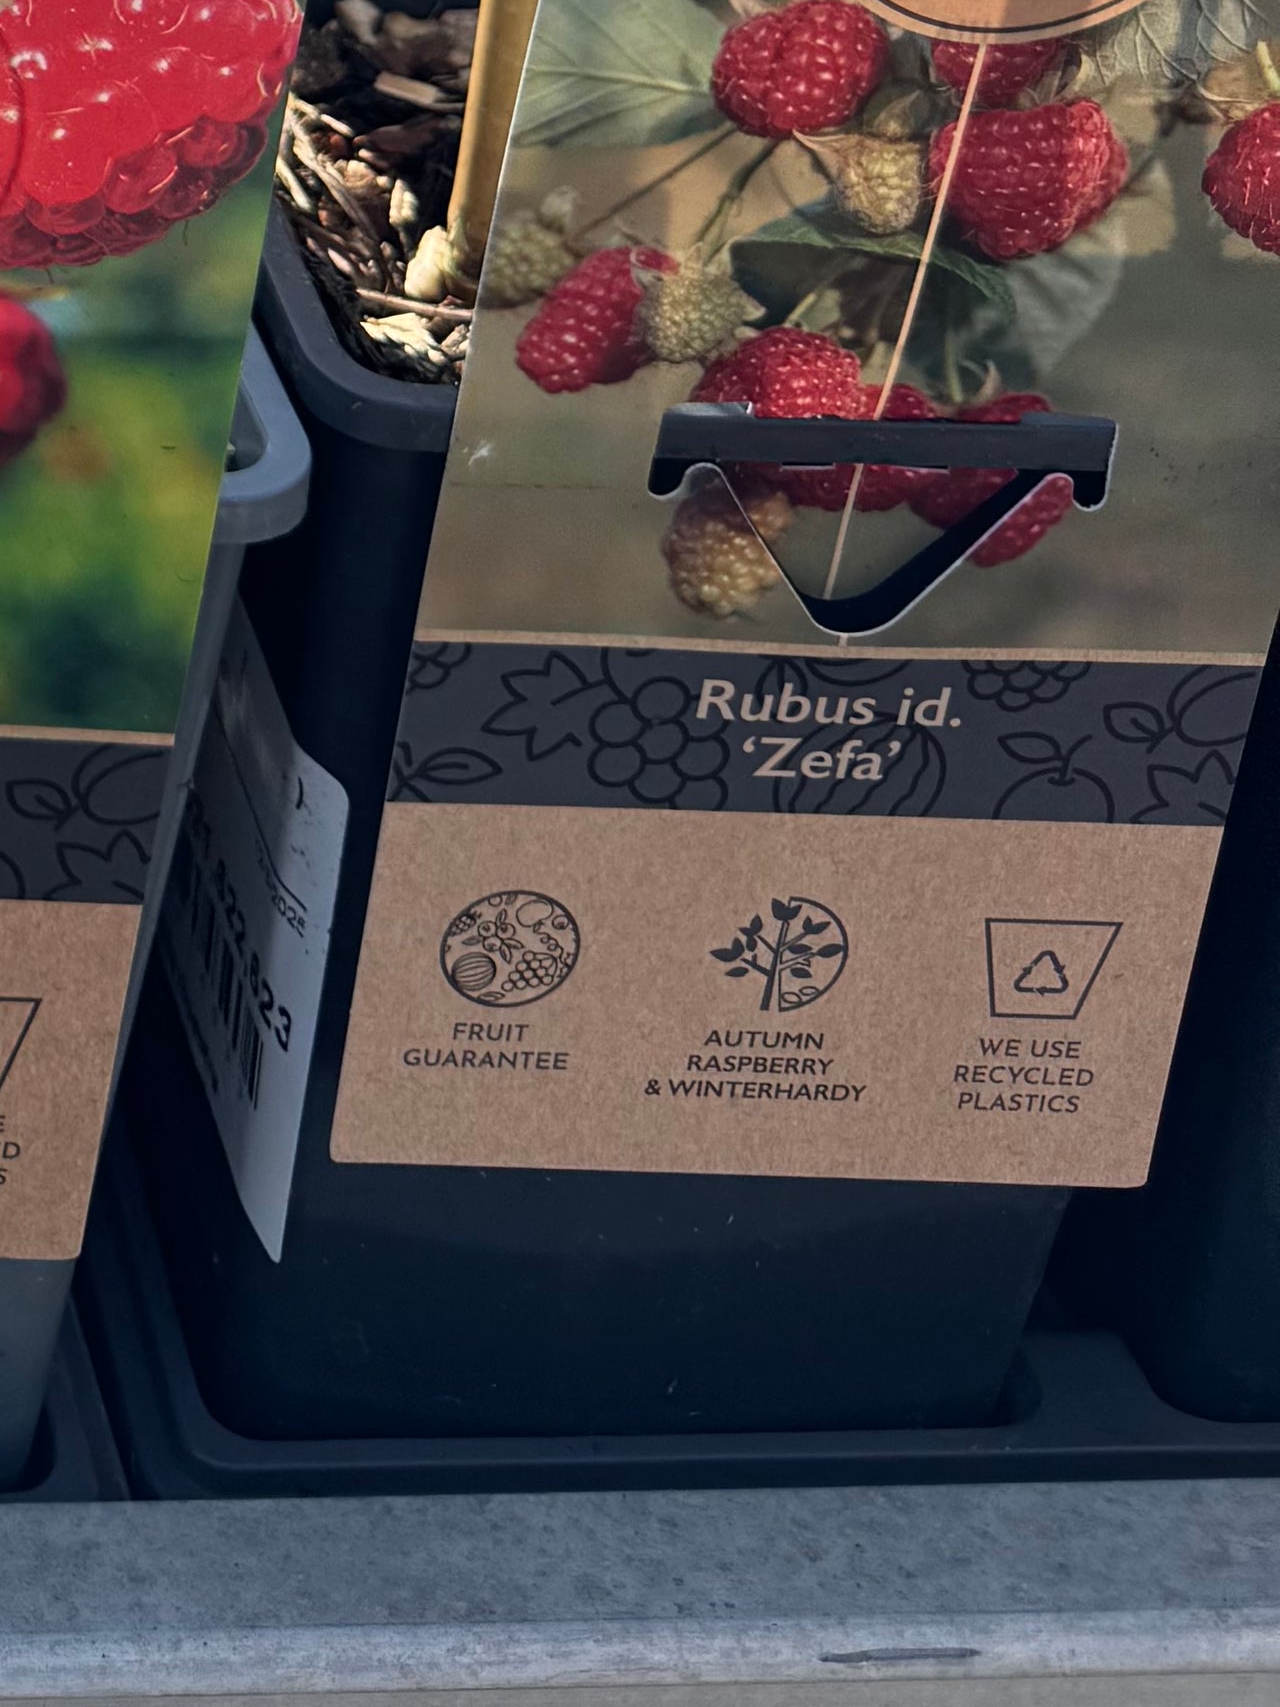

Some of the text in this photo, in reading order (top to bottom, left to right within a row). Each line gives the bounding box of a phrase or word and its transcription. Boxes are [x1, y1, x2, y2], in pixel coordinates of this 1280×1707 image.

[696, 679, 961, 727] Rubus id.
[453, 1022, 529, 1042] FRUIT
[704, 1030, 824, 1050] AUTUMN
[404, 1048, 569, 1070] GUARANTEE
[979, 1038, 1081, 1059] WE USE
[687, 1055, 834, 1075] RASPBERRY
[954, 1065, 1094, 1086] RECYCLED
[644, 1079, 867, 1102] & WINTERHARDY
[958, 1092, 1080, 1113] PLASTICS
